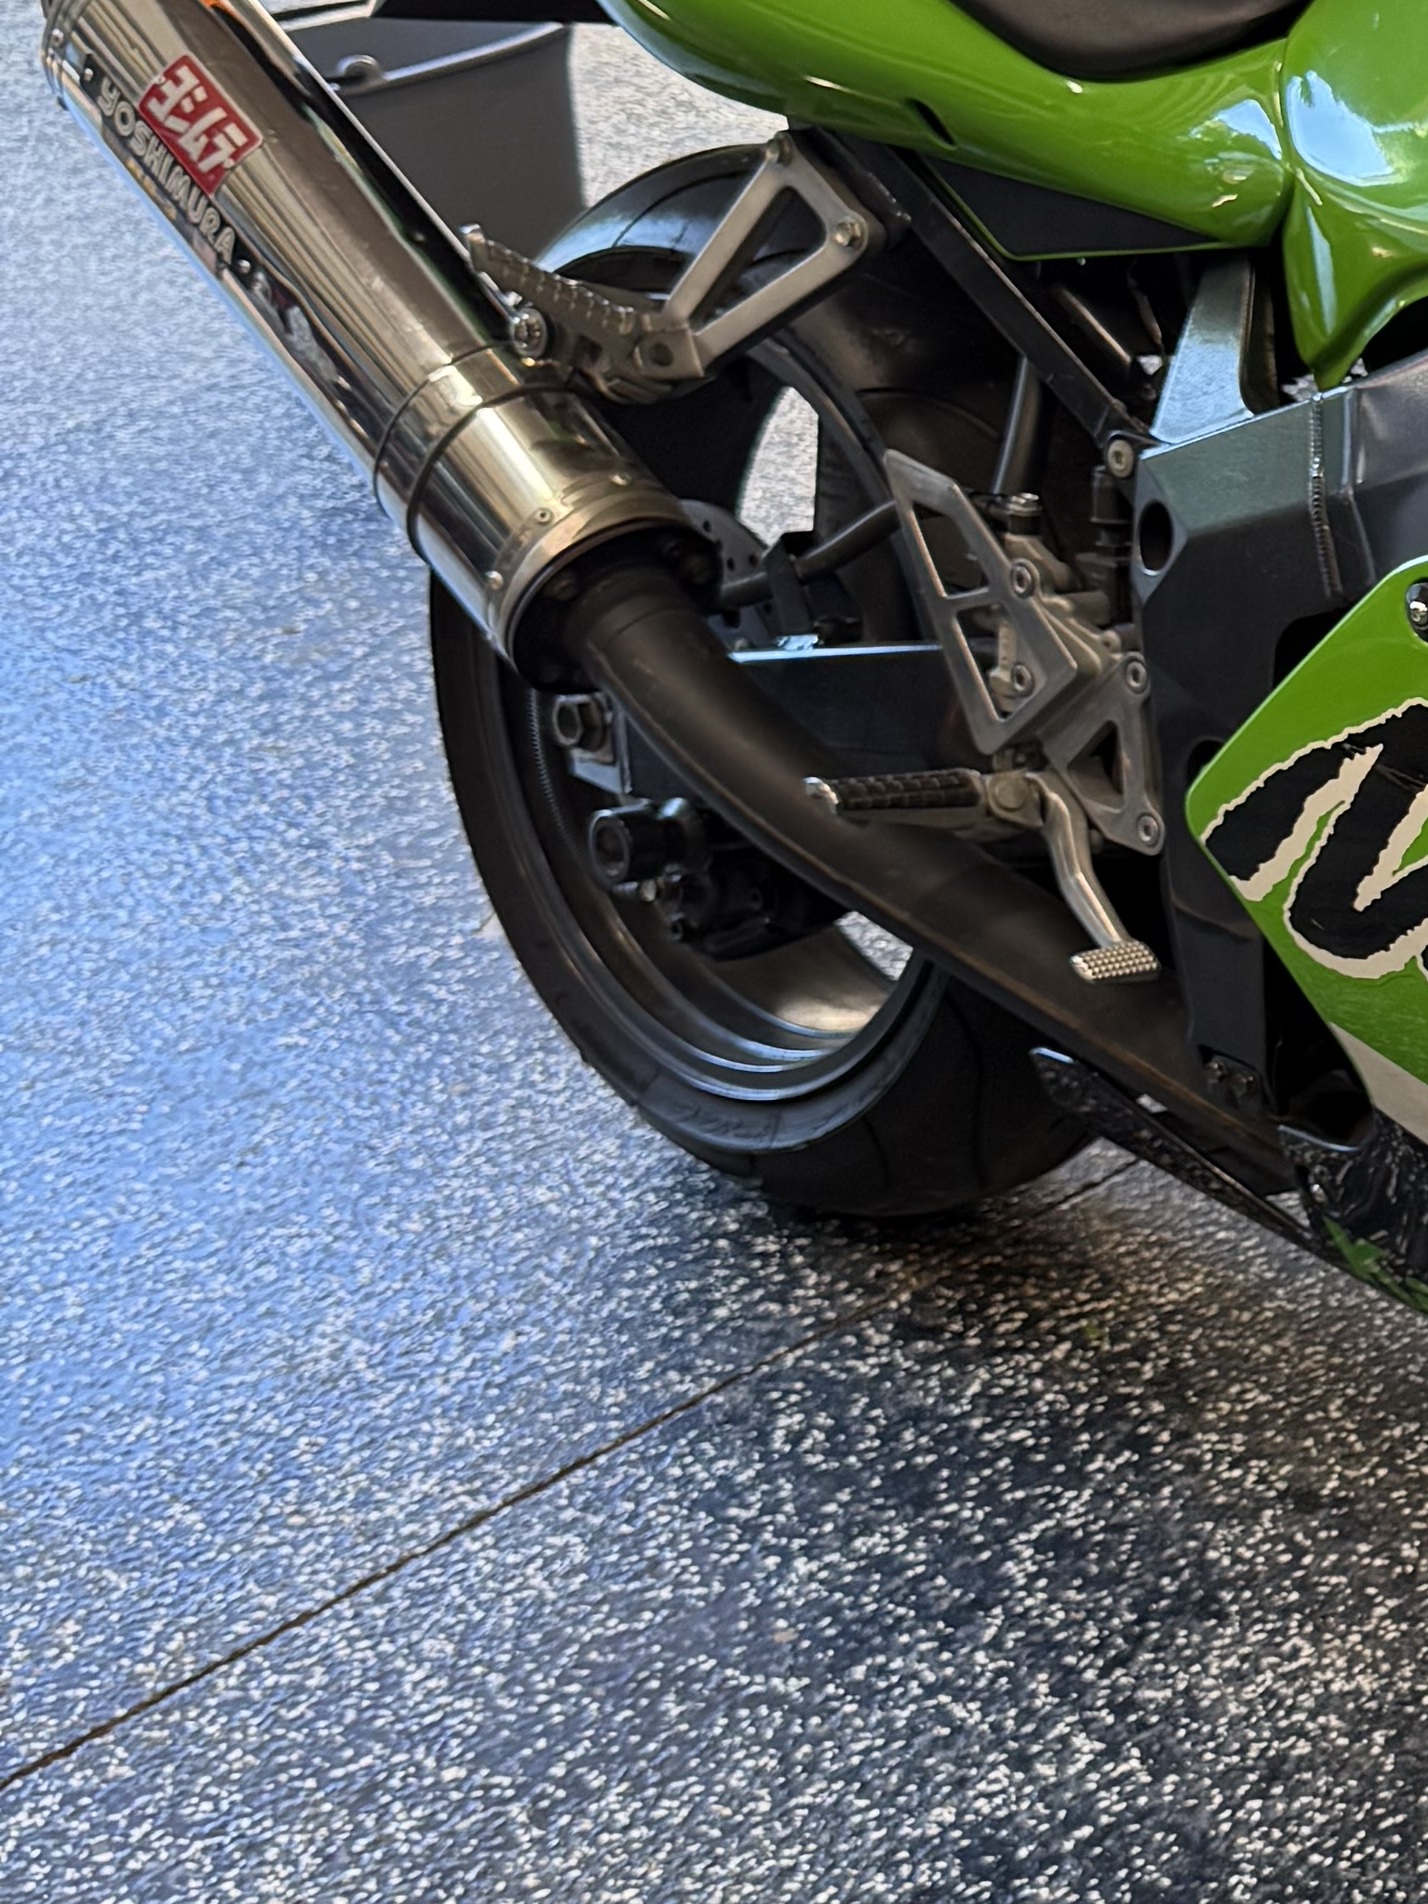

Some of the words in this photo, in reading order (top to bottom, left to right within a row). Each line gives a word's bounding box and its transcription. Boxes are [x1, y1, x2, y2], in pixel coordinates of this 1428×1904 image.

[97, 75, 237, 266] YOSHIMURA
[147, 65, 249, 174] ヨシムラ
